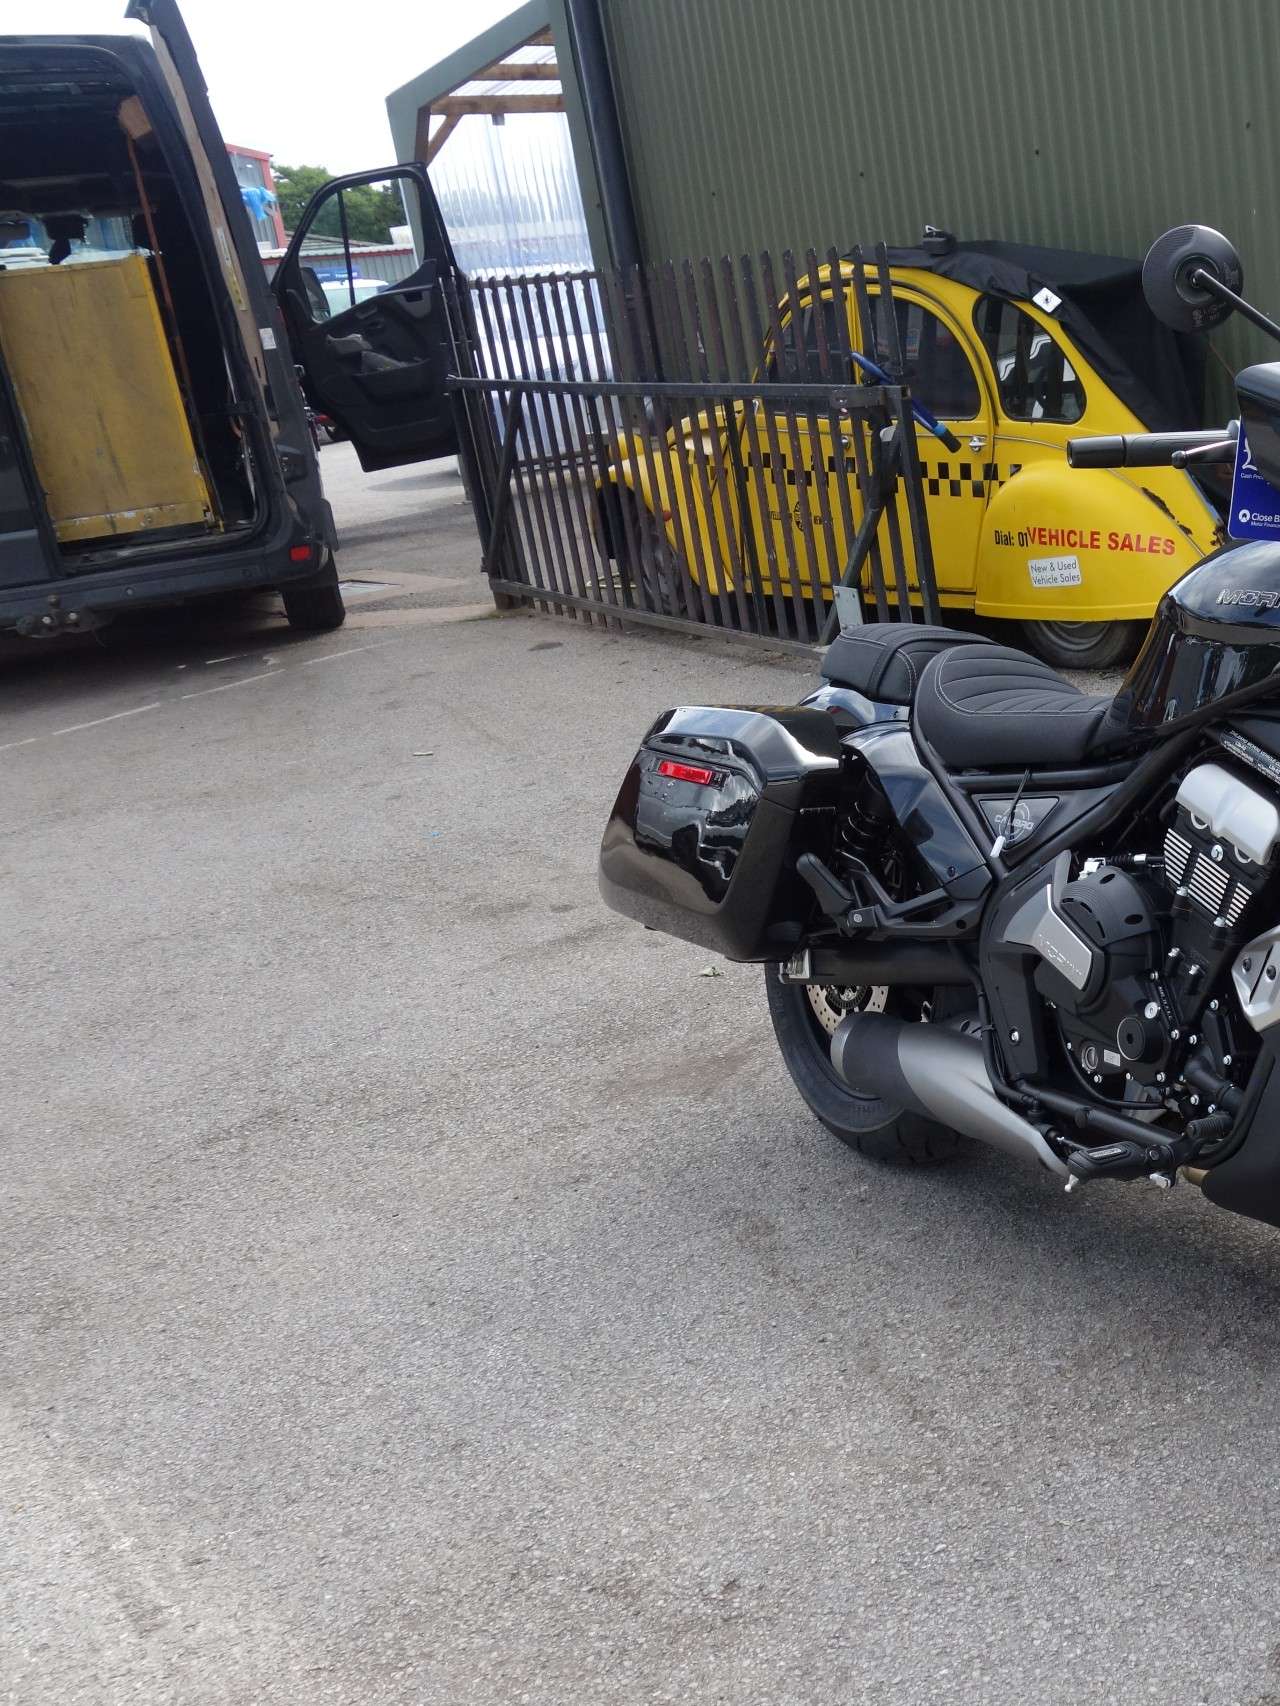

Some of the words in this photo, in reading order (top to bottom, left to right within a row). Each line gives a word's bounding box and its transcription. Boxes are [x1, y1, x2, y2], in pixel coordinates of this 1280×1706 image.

[1251, 512, 1273, 522] Close
[994, 530, 1015, 546] Dial:
[1026, 527, 1101, 550] VEHICLE
[1107, 532, 1176, 556] SALES
[1030, 563, 1048, 574] New
[1050, 562, 1055, 572] &
[1057, 560, 1077, 571] Used
[1032, 573, 1058, 585] Vehicle
[1060, 573, 1081, 584] Sales
